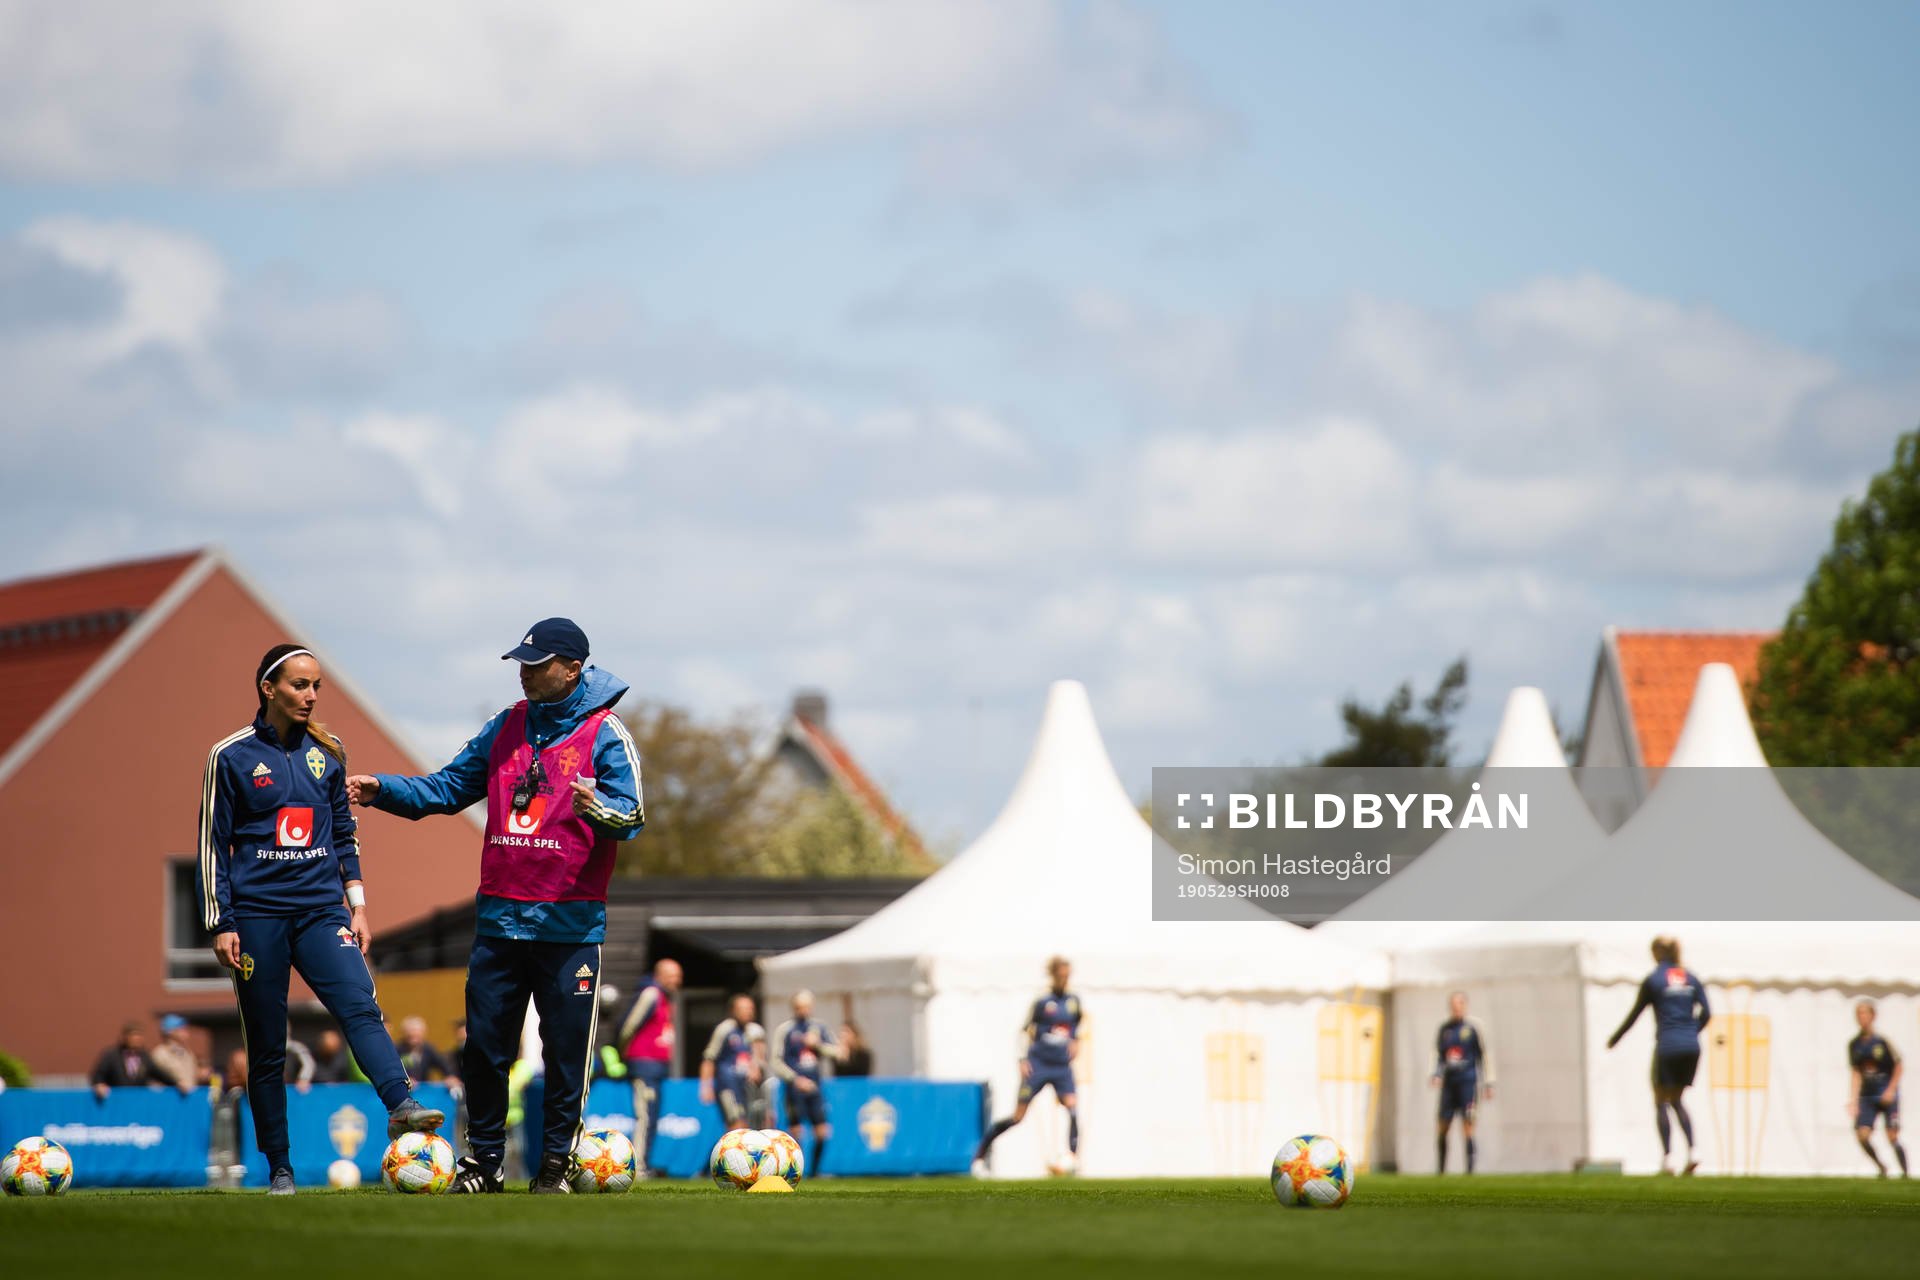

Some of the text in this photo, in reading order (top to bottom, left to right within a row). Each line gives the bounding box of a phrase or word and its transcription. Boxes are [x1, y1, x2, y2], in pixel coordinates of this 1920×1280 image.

[490, 835, 561, 849] SVENSKA SPEL
[256, 847, 328, 860] SVENSKA SPEL
